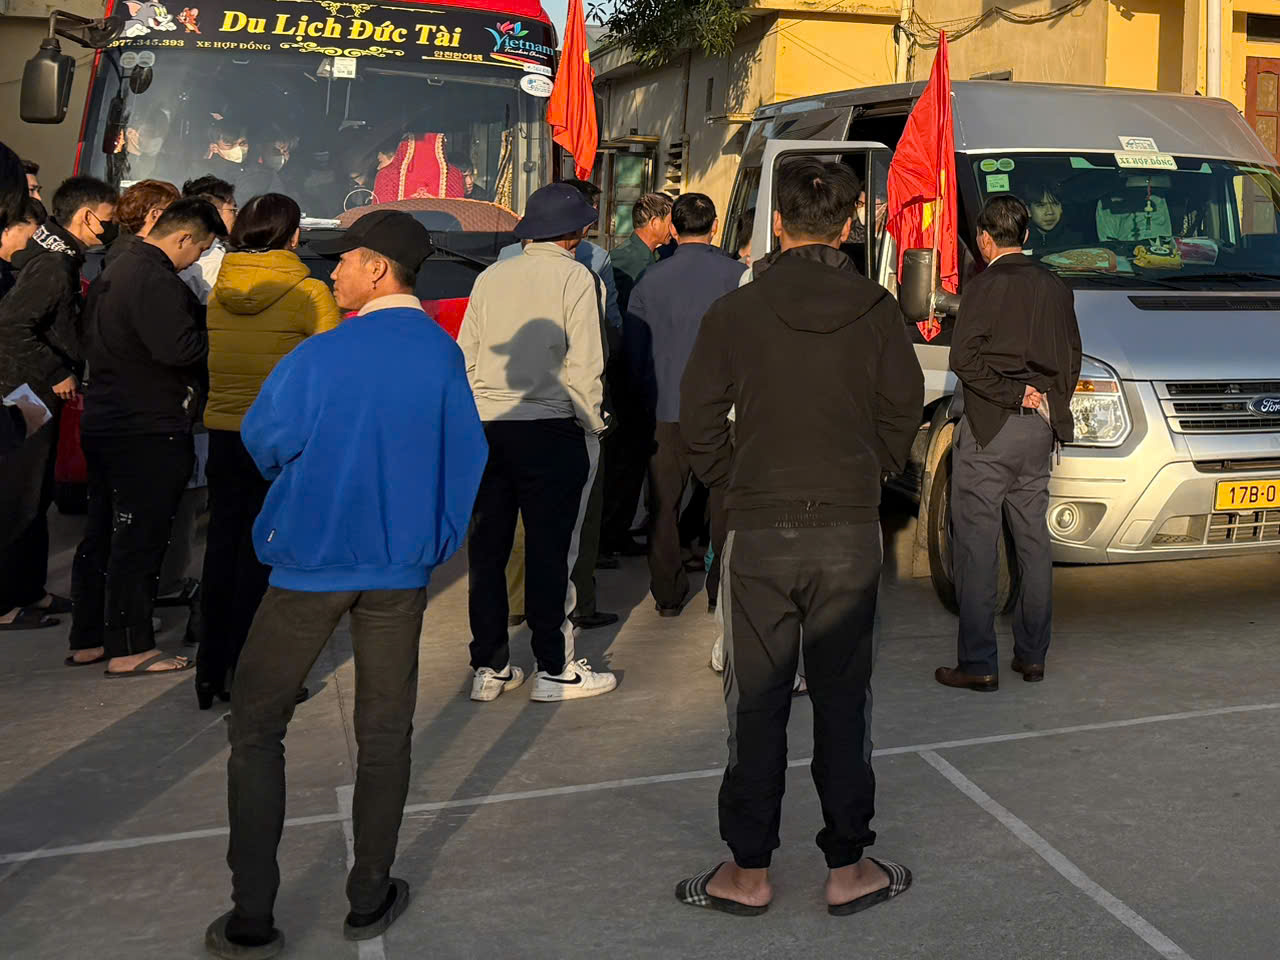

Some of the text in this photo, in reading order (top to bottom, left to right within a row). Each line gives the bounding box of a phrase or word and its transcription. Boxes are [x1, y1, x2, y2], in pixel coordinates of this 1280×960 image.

[218, 10, 463, 47] Du Lịch Đức Tài
[106, 39, 185, 49] 977.345.393
[213, 41, 238, 49] HỢP
[484, 26, 555, 56] Vietnam
